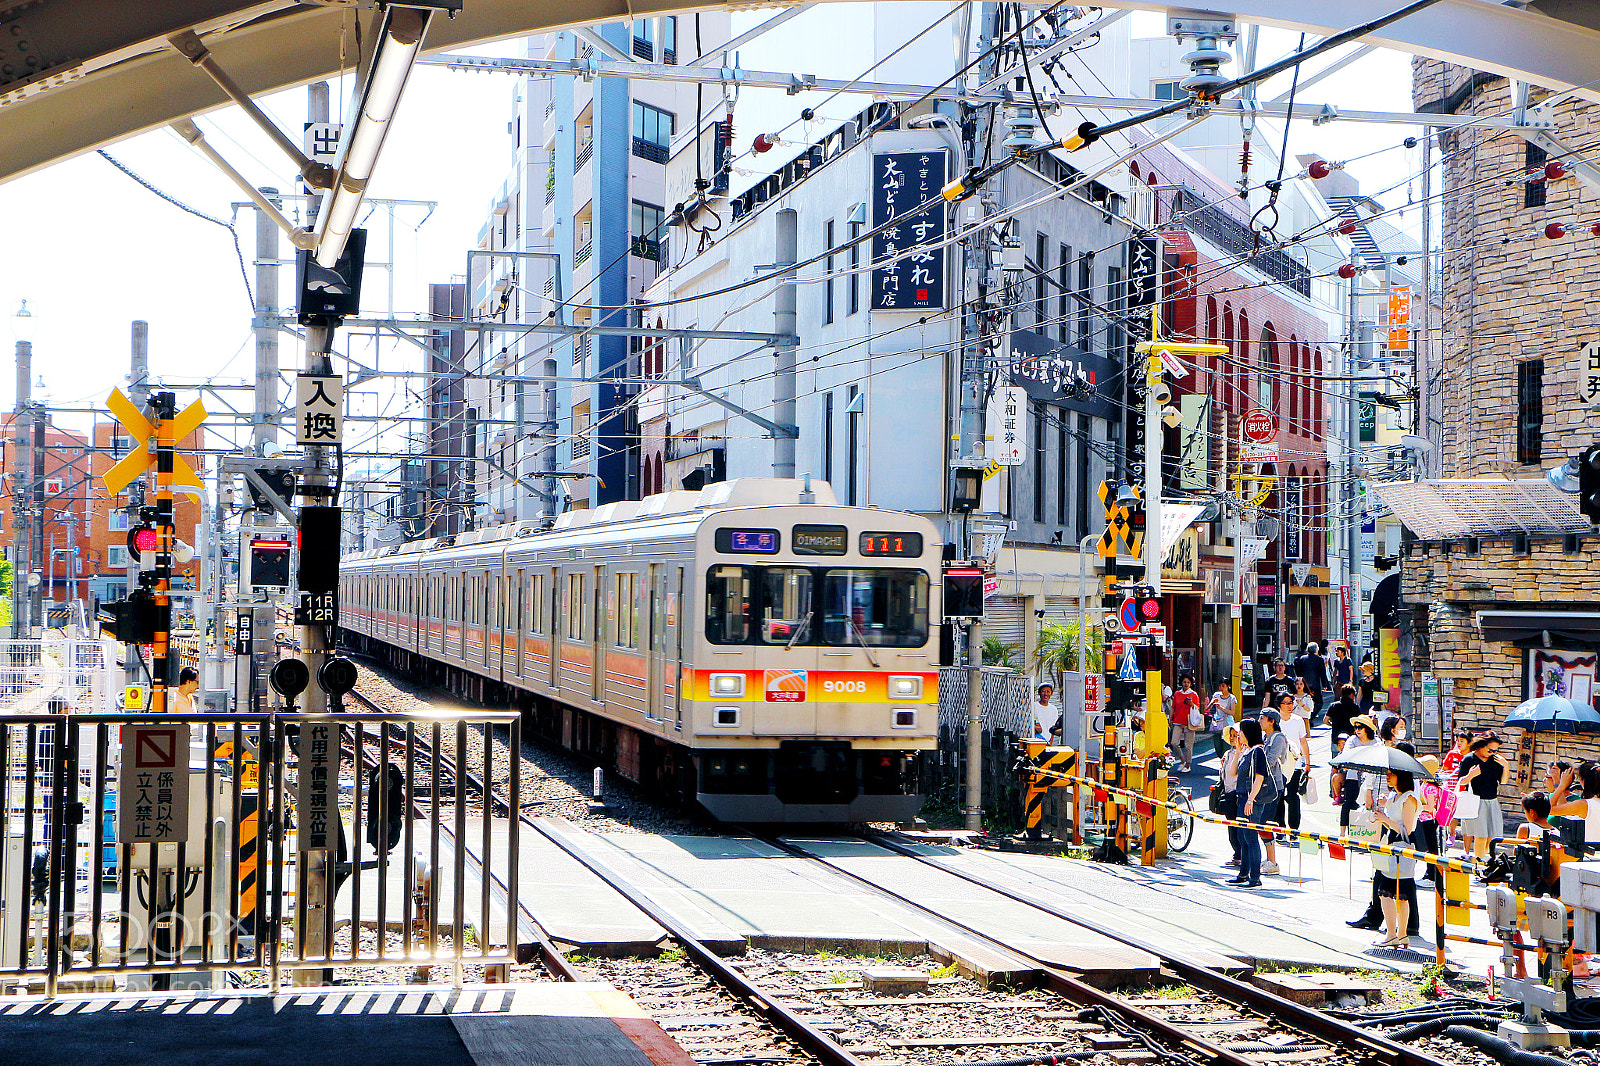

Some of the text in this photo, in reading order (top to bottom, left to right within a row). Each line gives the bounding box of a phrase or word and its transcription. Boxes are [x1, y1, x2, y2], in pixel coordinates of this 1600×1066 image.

[304, 380, 337, 440] 入換
[1004, 391, 1017, 444] 大和証券
[1247, 421, 1270, 433] 消火栓
[736, 534, 771, 546] 各停
[866, 537, 904, 552] 111
[306, 596, 334, 608] 11R
[306, 608, 334, 621] 12R
[239, 616, 250, 654] 自由1
[1382, 638, 1402, 690] SALE
[823, 680, 867, 693] 9008
[1518, 736, 1533, 783] 営業中
[135, 772, 153, 838] 立入禁止
[156, 771, 174, 838] 係員以外
[310, 726, 328, 848] 代用手信号現示位置
[1547, 909, 1558, 920] R3
